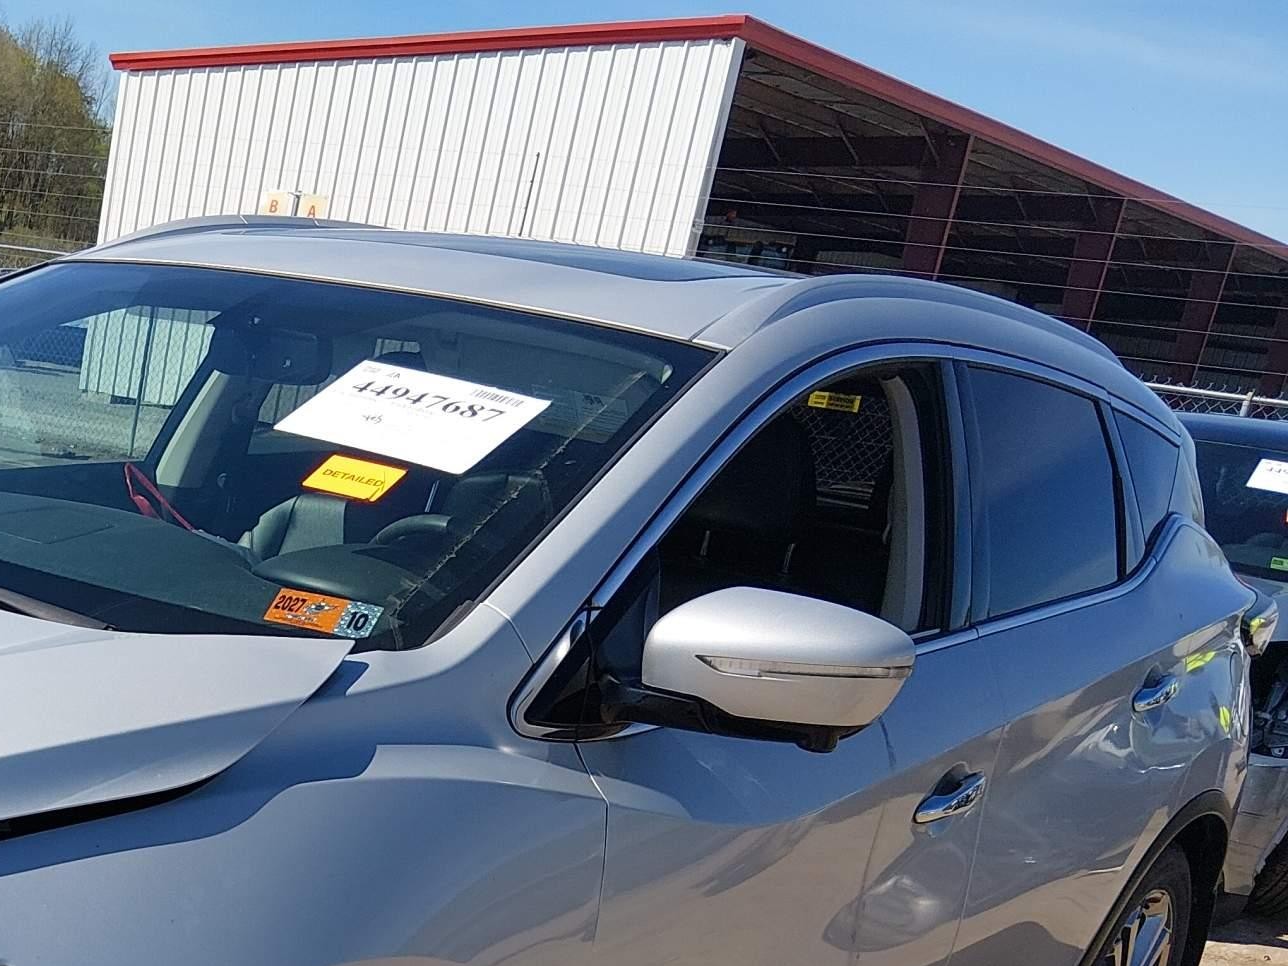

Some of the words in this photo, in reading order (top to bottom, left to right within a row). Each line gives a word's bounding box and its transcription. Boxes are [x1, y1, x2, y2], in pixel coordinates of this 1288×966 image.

[268, 199, 279, 214] B
[306, 205, 317, 219] A
[352, 380, 507, 423] 44947687
[322, 468, 385, 488] DETAILED
[273, 594, 308, 614] 2027
[346, 611, 369, 631] 10
